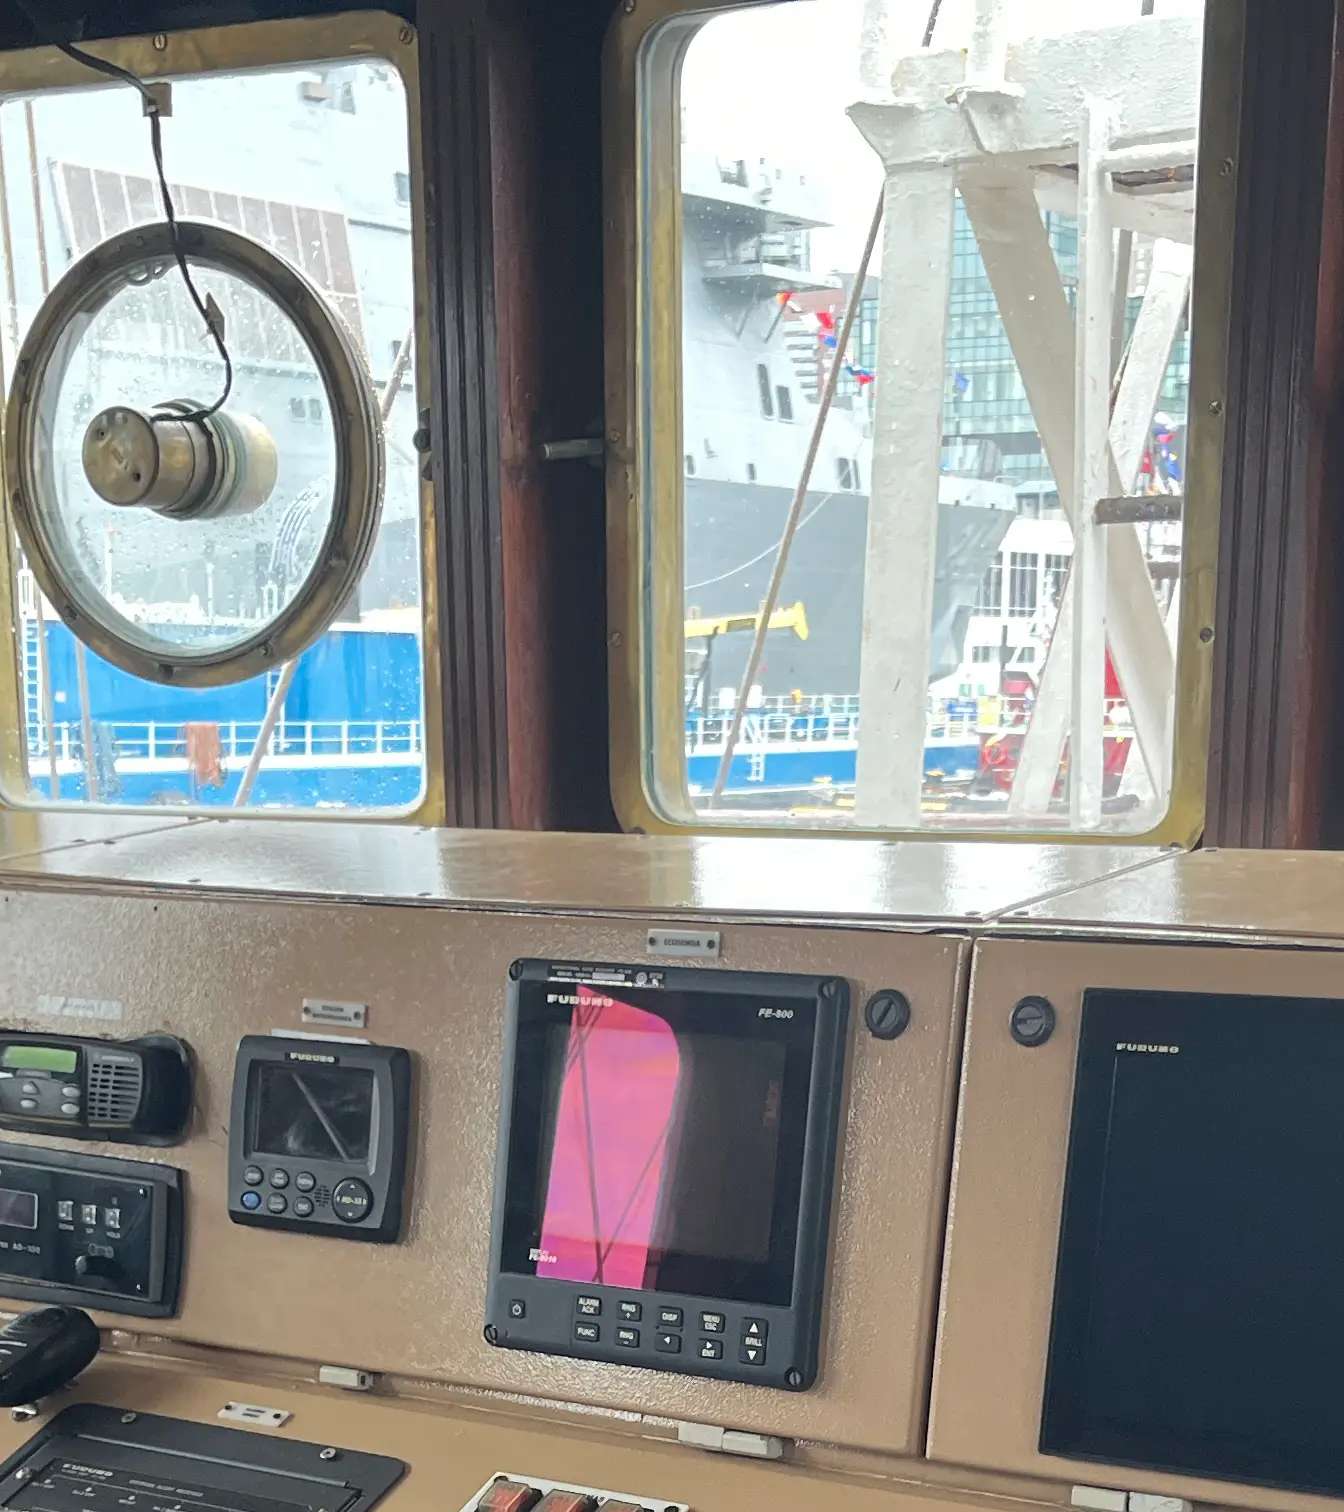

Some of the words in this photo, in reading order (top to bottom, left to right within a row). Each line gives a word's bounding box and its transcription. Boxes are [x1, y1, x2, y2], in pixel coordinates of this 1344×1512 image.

[663, 938, 701, 947] ECOSONDA
[546, 994, 614, 1008] FURUNO
[758, 1008, 794, 1019] FE-800
[1116, 1042, 1180, 1054] FURUNO
[289, 1052, 336, 1063] FURUNO
[661, 1311, 678, 1322] DISP
[577, 1327, 596, 1338] FUNC
